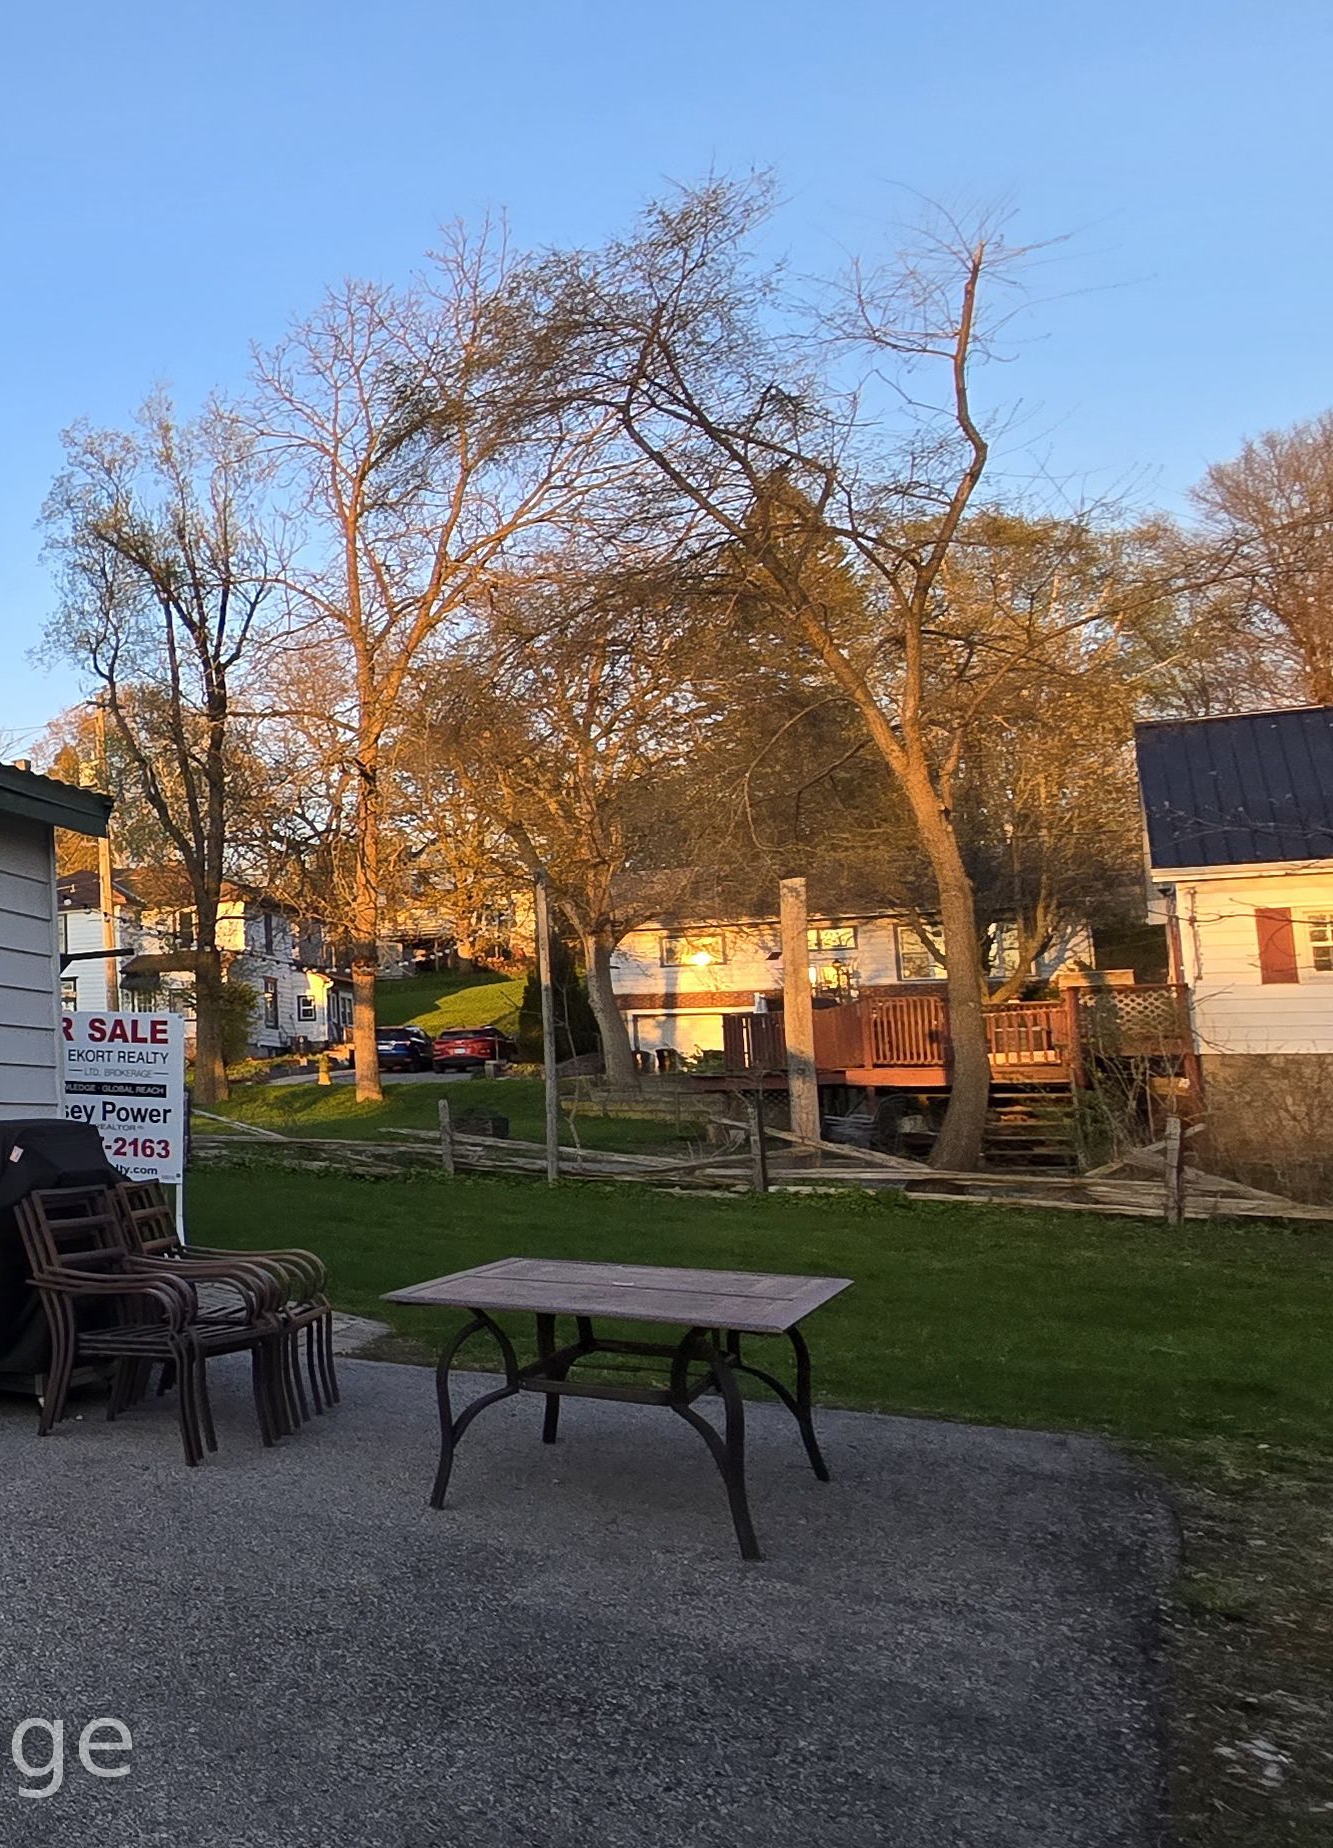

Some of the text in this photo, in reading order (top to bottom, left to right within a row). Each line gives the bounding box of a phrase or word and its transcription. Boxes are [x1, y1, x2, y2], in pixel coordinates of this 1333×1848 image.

[88, 1018, 169, 1044] SALE
[68, 1049, 169, 1064] EKORT REALTY
[104, 1068, 152, 1078] BROKERAGE
[101, 1085, 134, 1093] GLOBAL
[136, 1086, 164, 1094] REACH
[102, 1101, 172, 1123] Power
[101, 1136, 170, 1159] -2163
